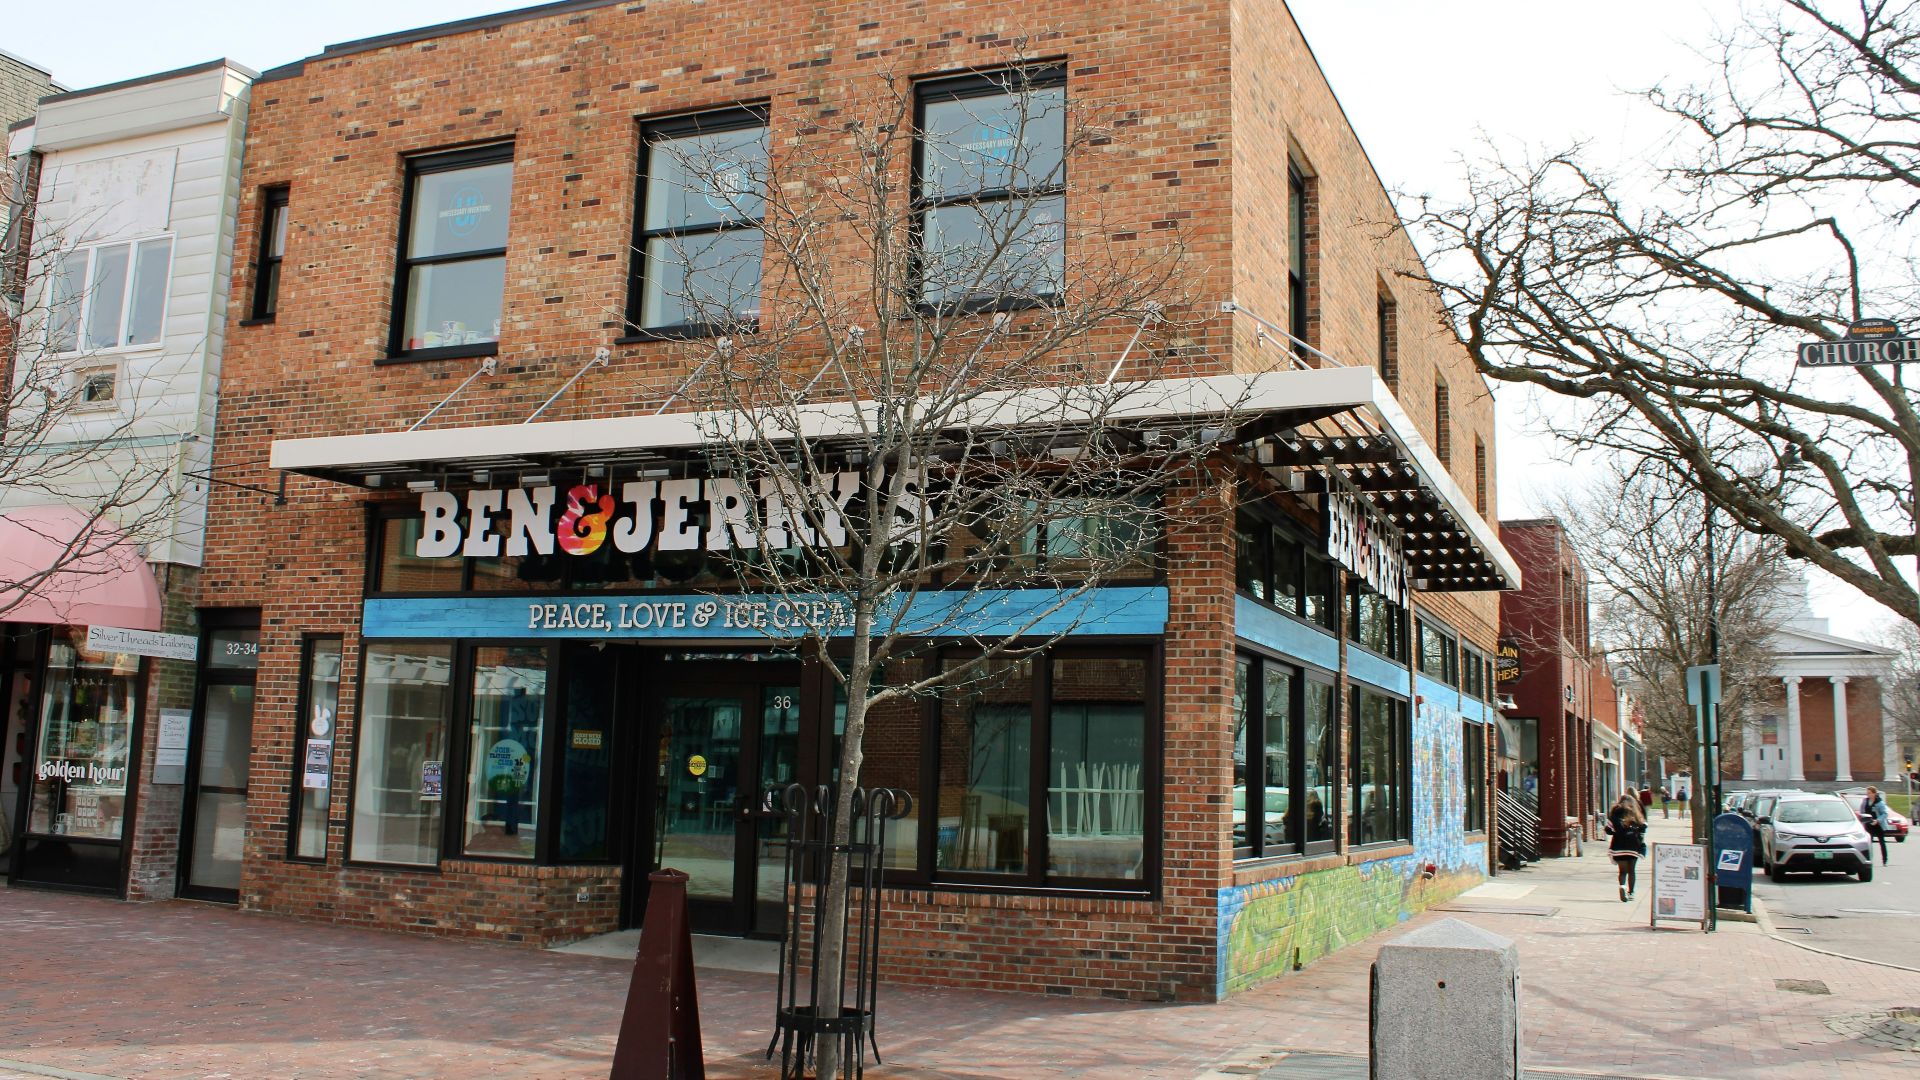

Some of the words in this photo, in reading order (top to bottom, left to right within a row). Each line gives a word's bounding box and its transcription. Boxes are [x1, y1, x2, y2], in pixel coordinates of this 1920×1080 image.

[1803, 340, 1920, 365] CHURCH
[528, 603, 613, 632] PEACE,
[618, 602, 686, 629] LOVE
[724, 602, 767, 628] ICE
[90, 627, 118, 643] Silver
[119, 631, 159, 647] Threads
[159, 635, 196, 653] Tailoring
[226, 643, 257, 655] 32-34
[774, 695, 791, 709] 36
[39, 760, 85, 784] golden
[89, 762, 125, 785] hour
